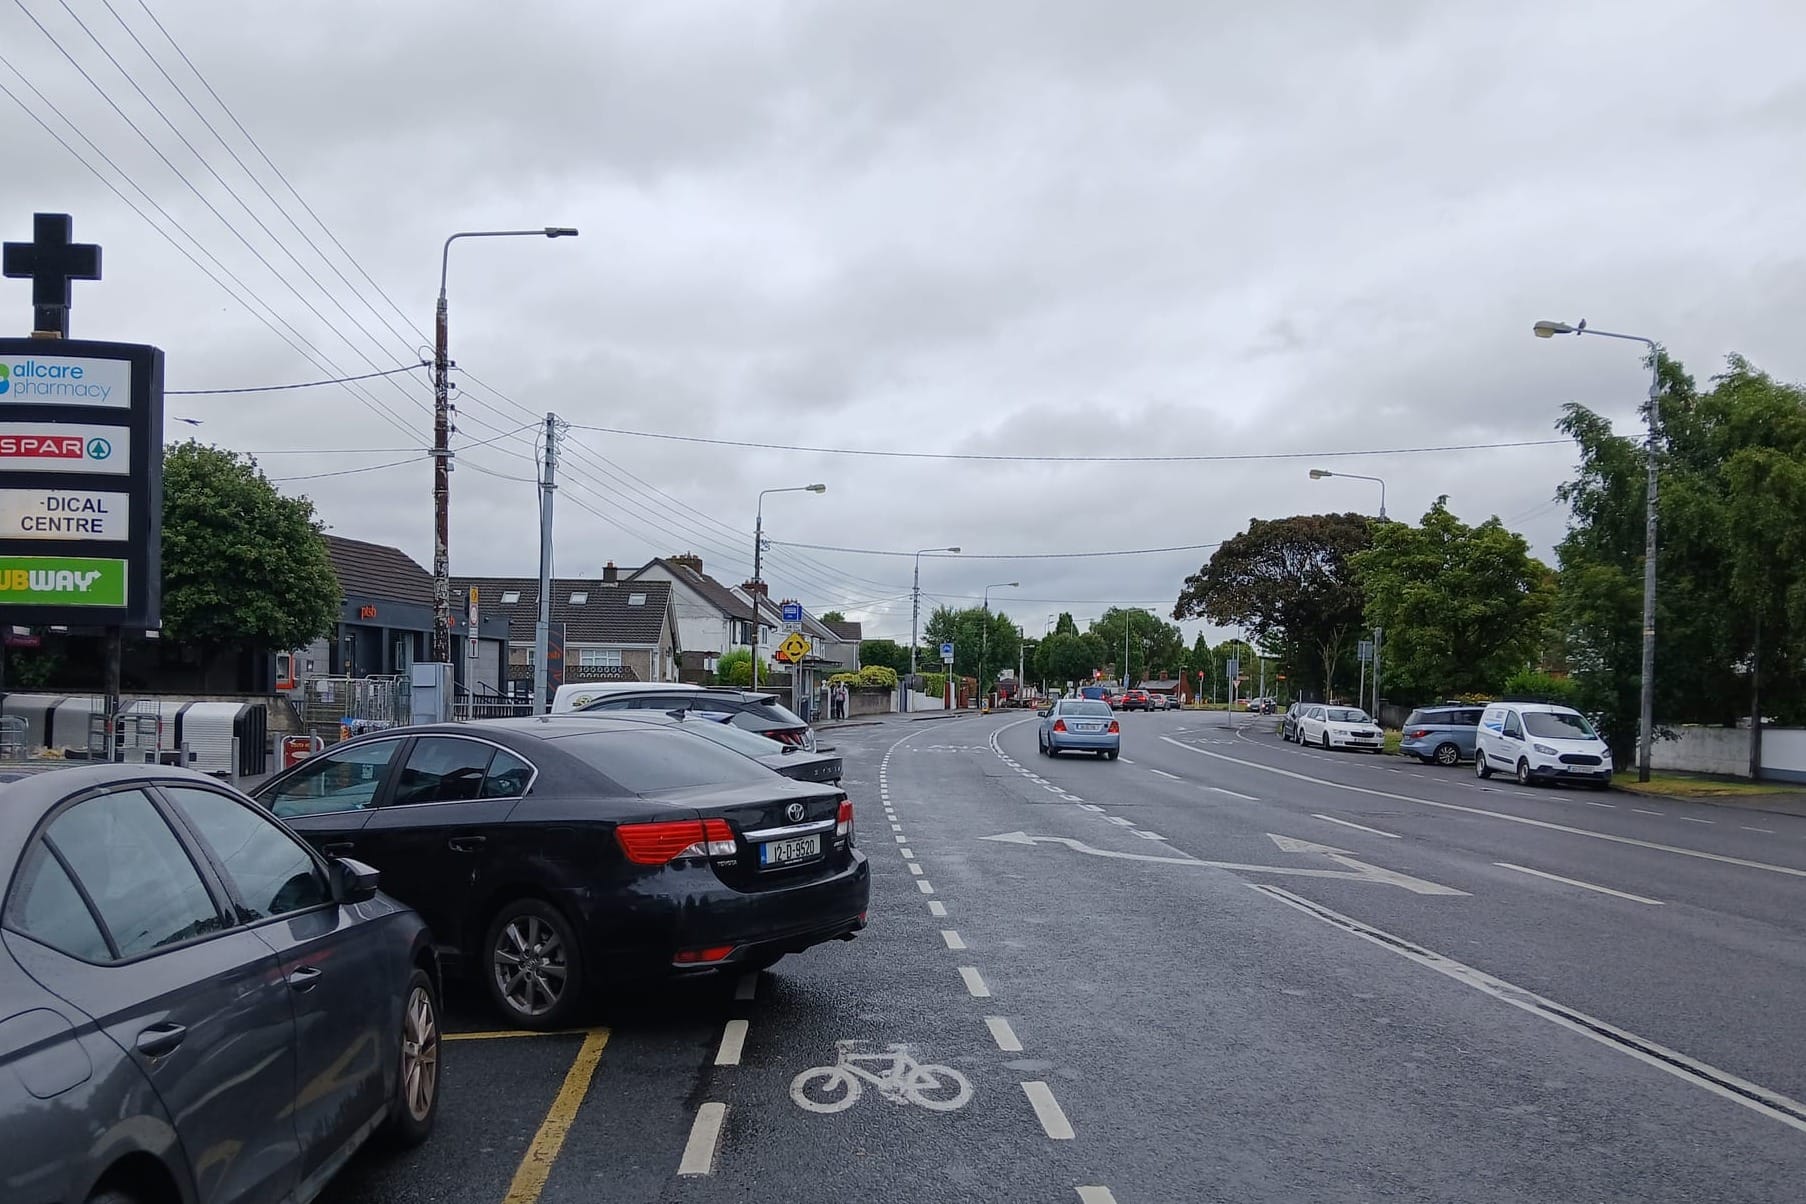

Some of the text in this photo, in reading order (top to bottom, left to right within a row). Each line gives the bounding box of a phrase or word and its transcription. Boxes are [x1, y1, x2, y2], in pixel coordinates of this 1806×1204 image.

[13, 360, 83, 379] allcare
[14, 379, 111, 402] pharmacy
[0, 439, 81, 454] SPAR
[21, 516, 103, 533] CENTRE
[0, 569, 102, 592] UBWAY
[774, 840, 815, 861] 12-D-9520
